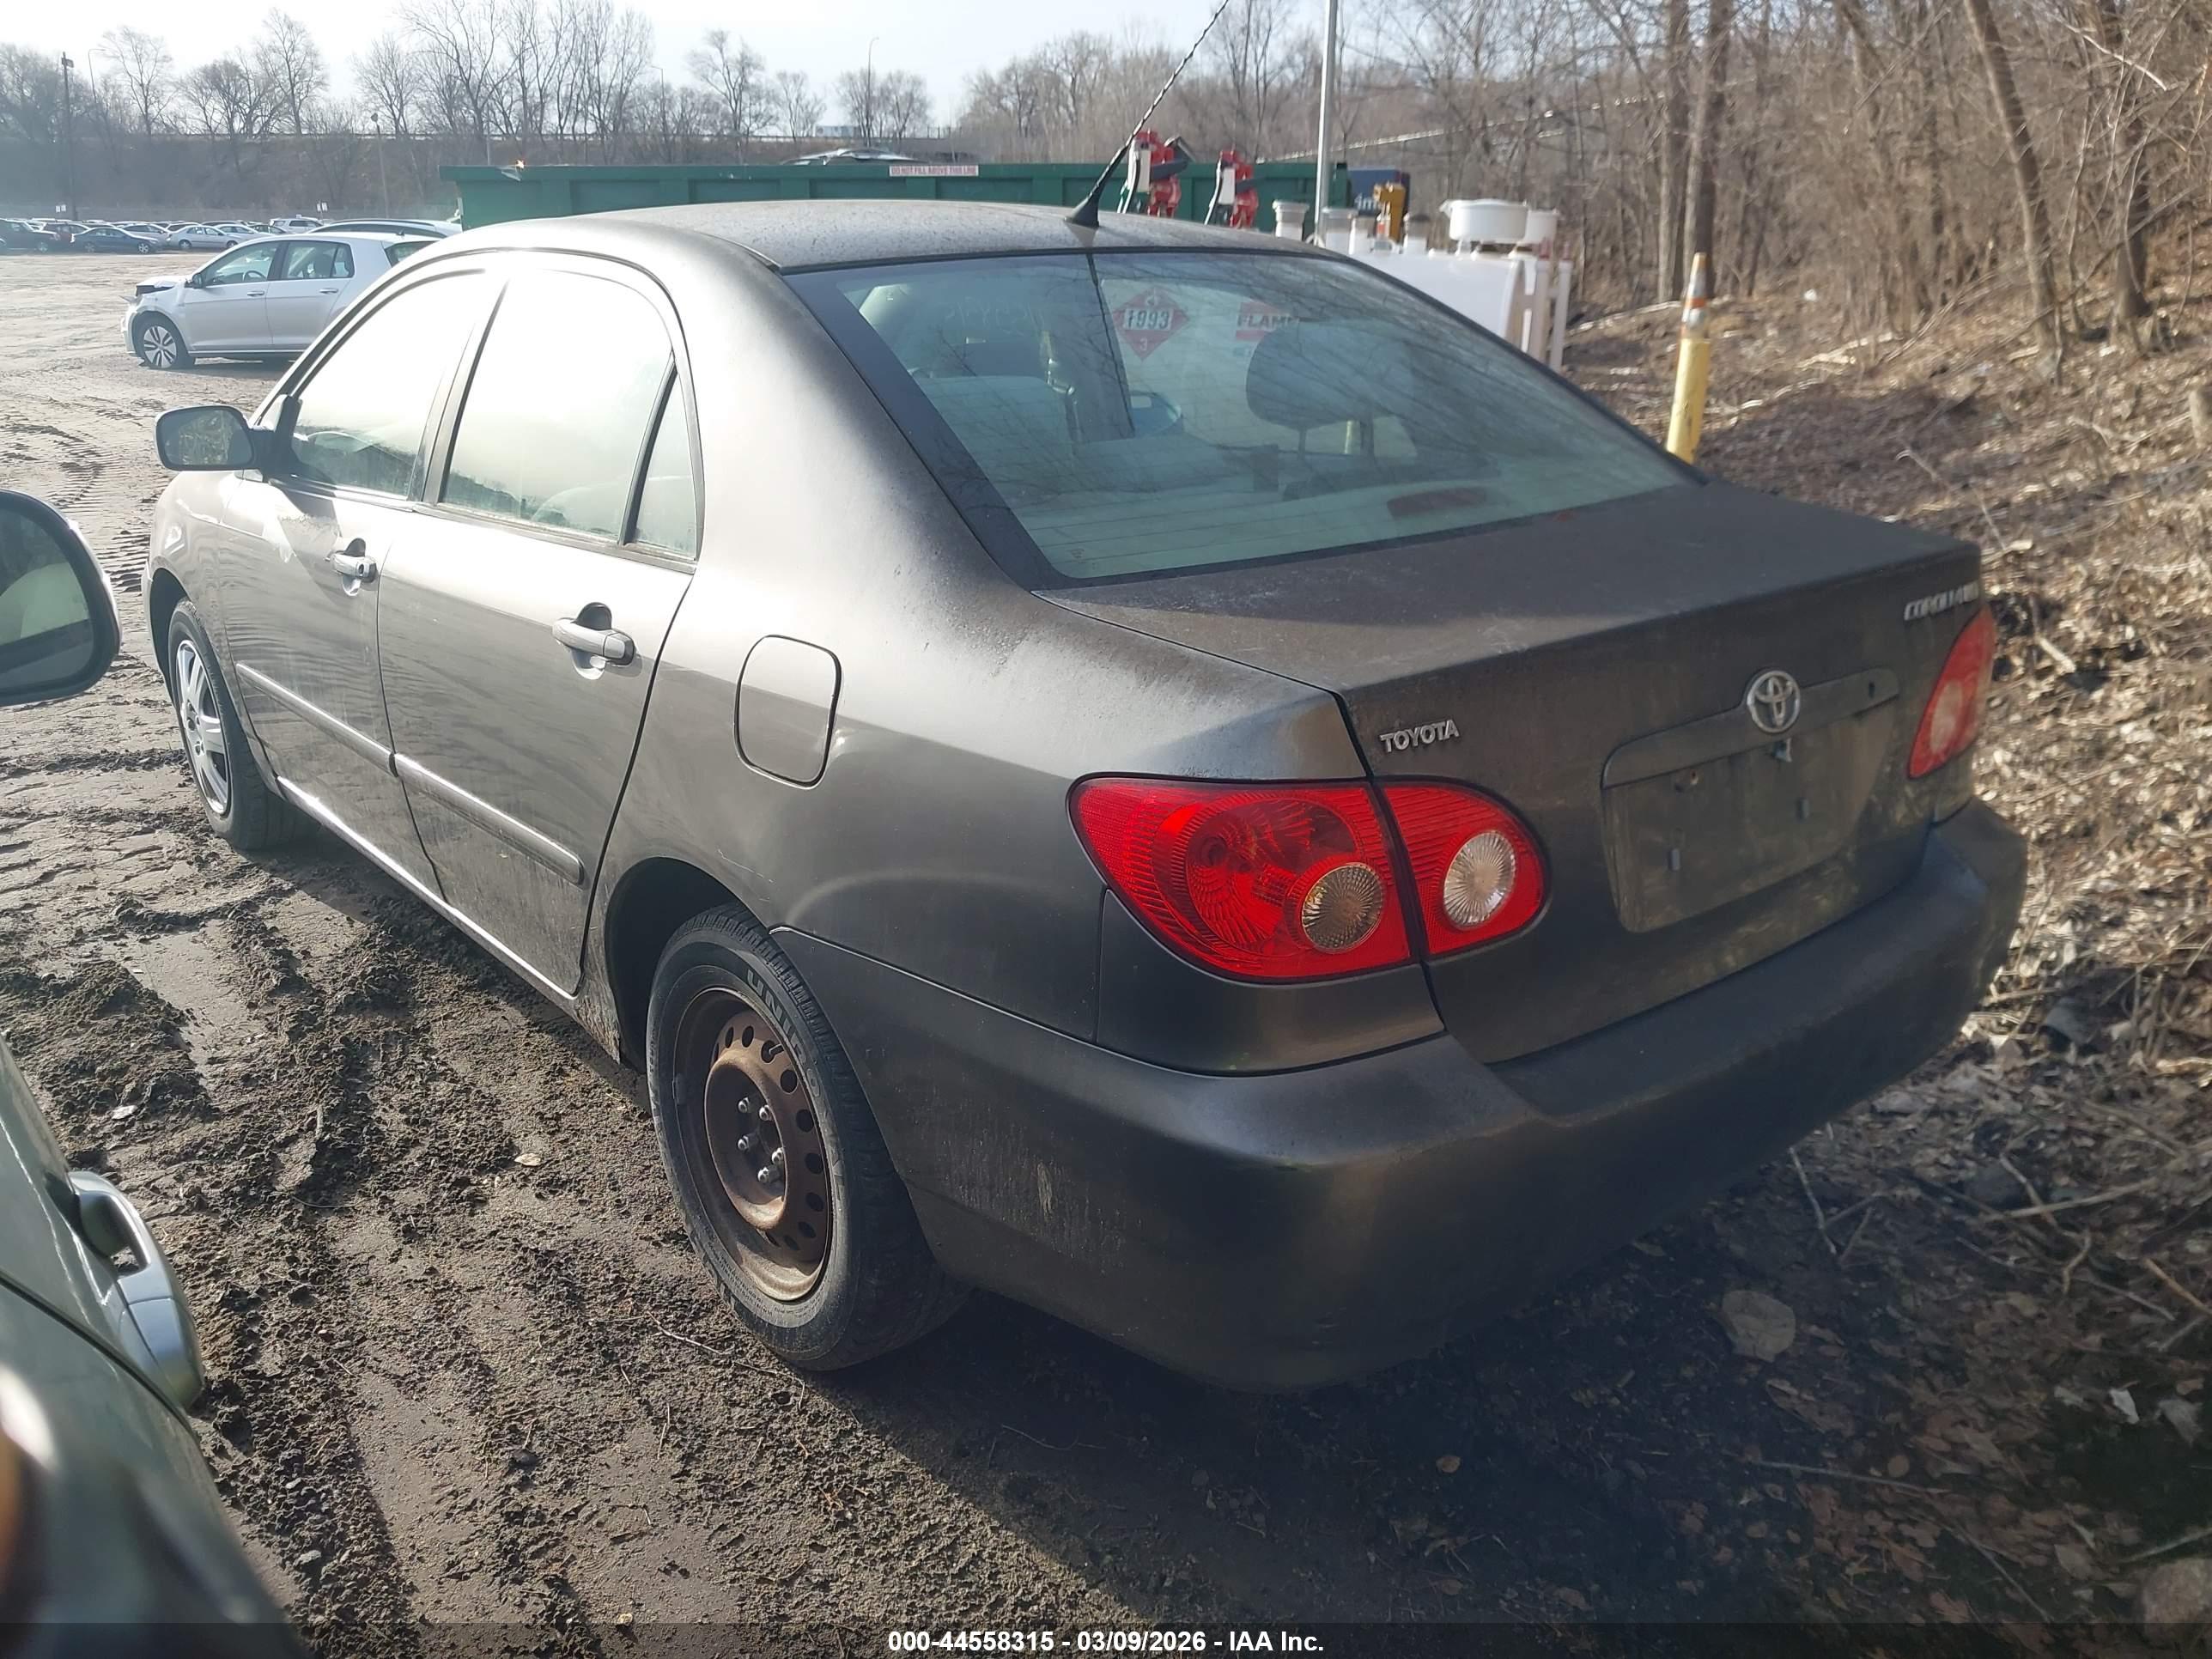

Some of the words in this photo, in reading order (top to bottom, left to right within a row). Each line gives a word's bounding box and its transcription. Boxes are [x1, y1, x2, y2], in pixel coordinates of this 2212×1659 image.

[1127, 310, 1170, 330] 1993
[1139, 337, 1149, 351] 3
[1379, 719, 1460, 753] TOYOTA
